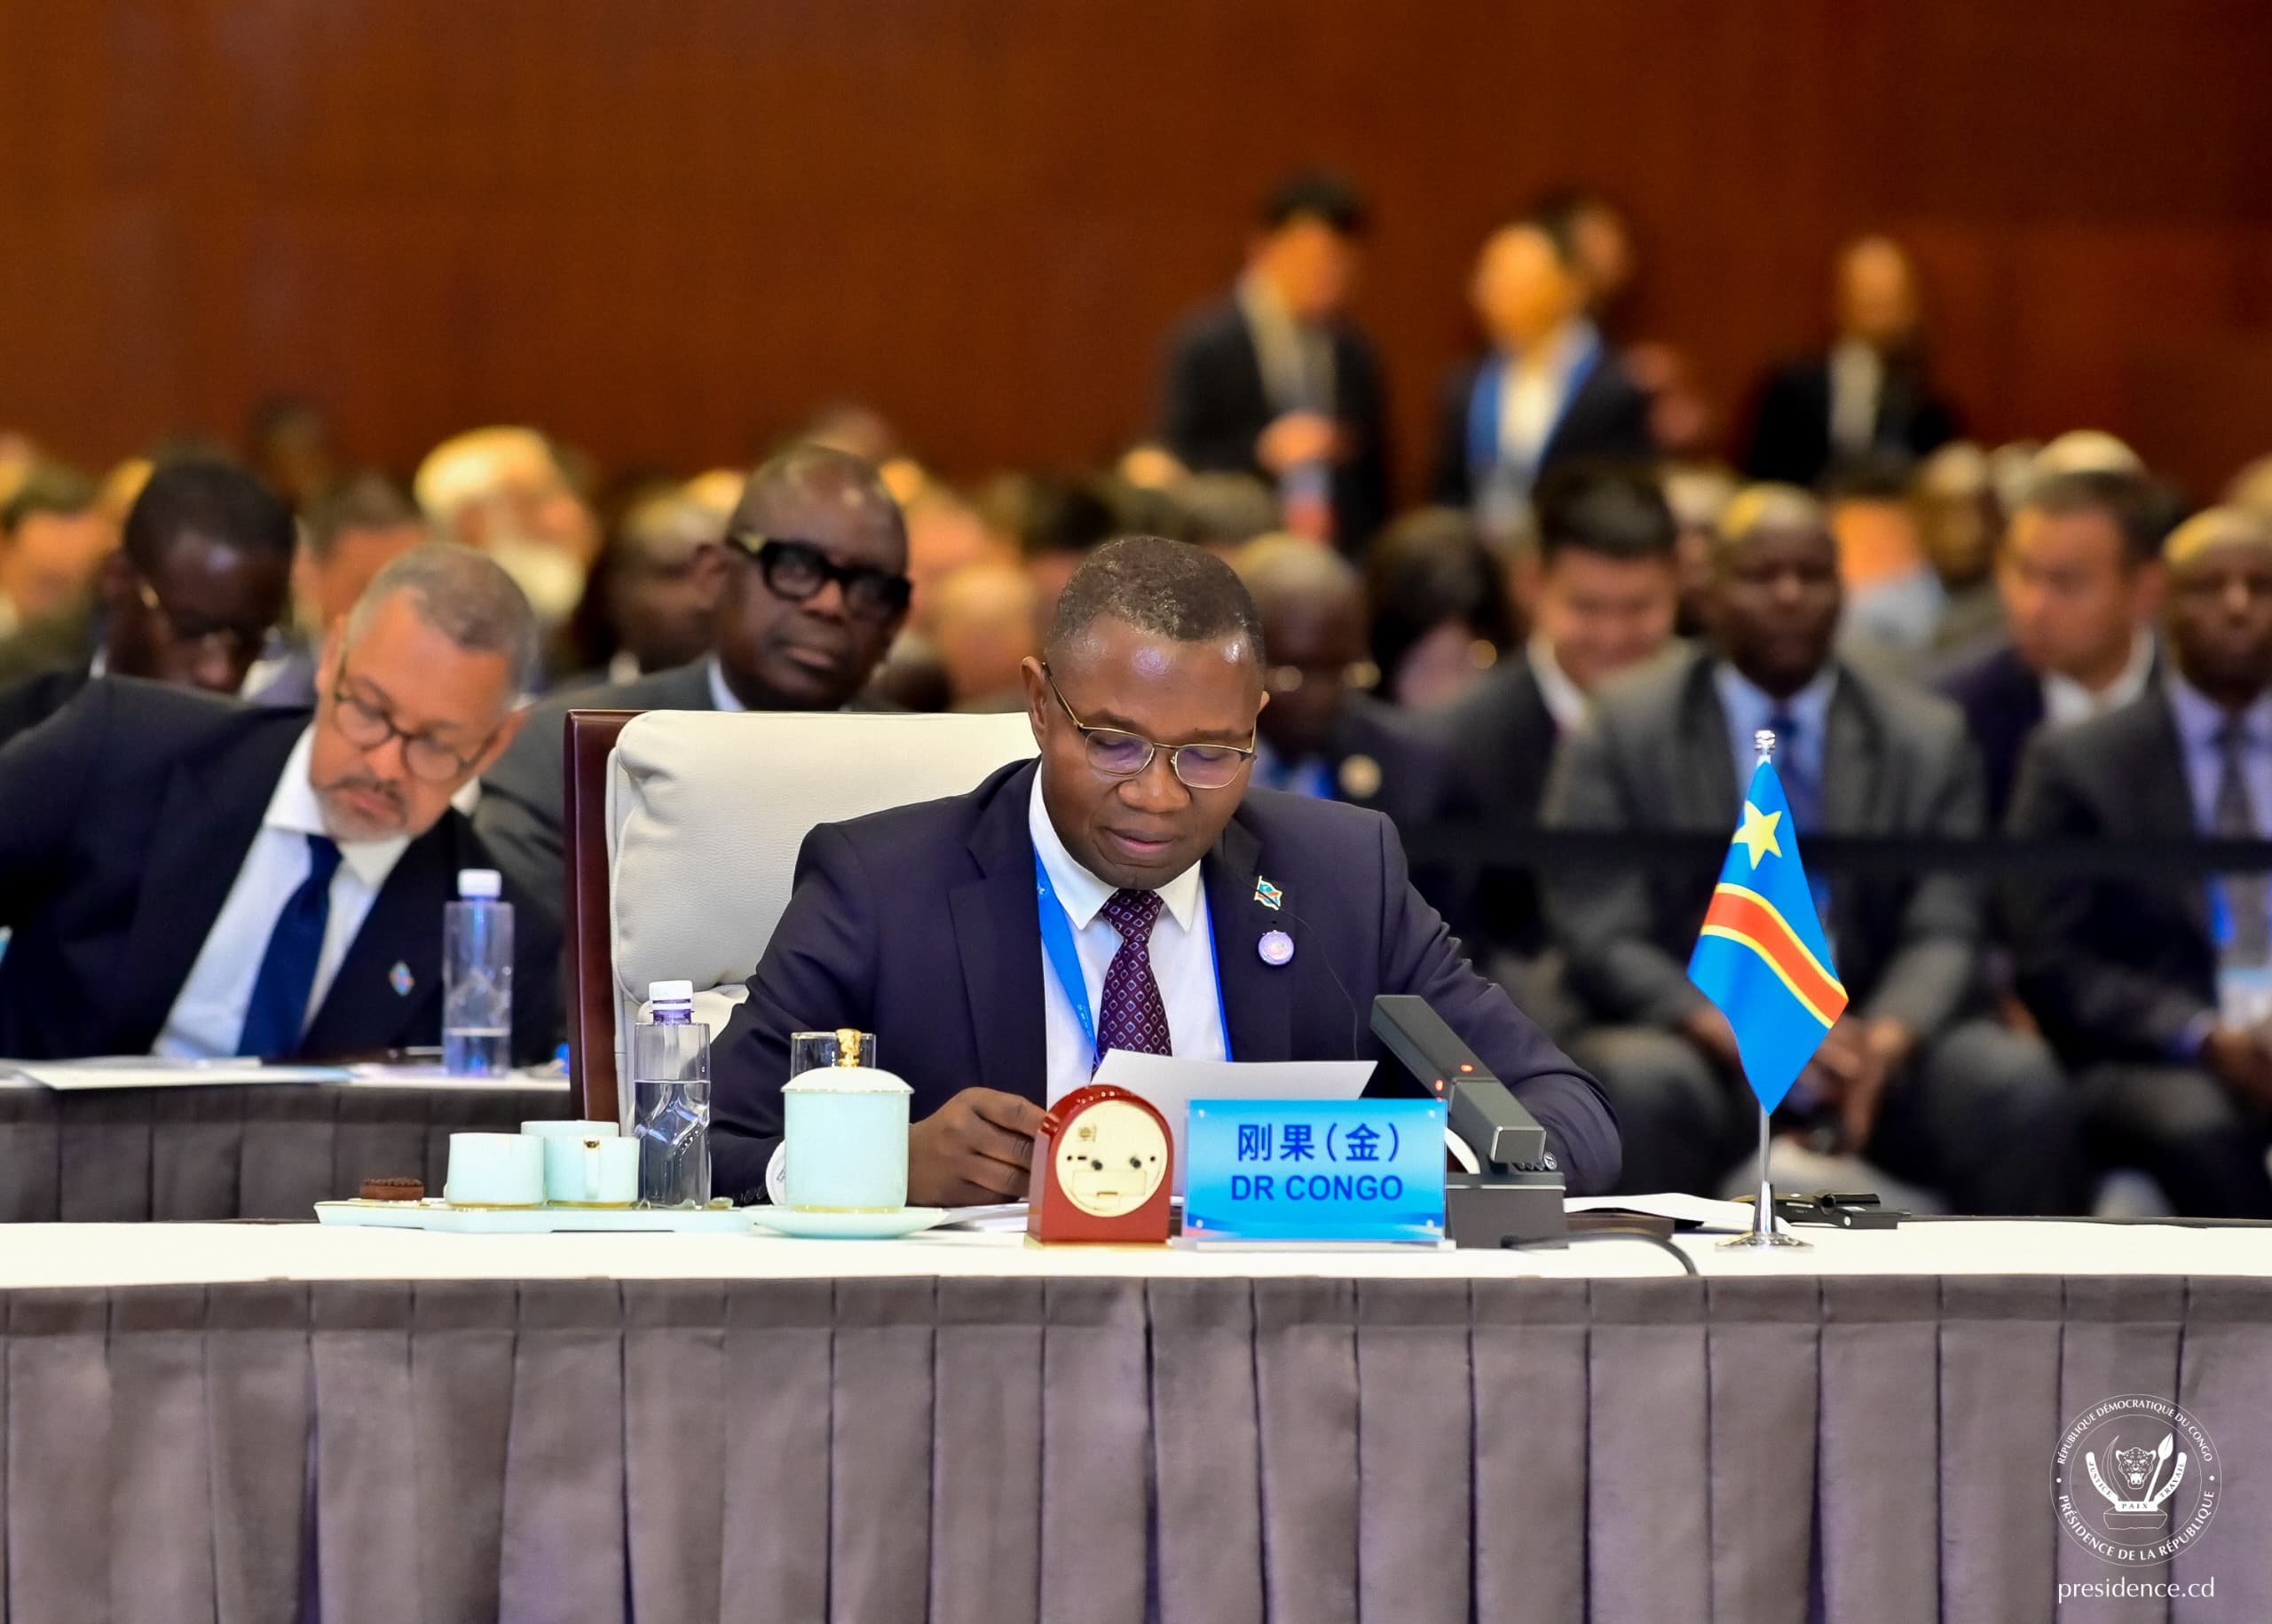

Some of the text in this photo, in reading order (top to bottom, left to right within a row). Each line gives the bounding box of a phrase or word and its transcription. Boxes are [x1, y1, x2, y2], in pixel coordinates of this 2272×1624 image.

[1237, 1123, 1400, 1163] 刚果（金）
[1231, 1175, 1403, 1201] DR CONGO
